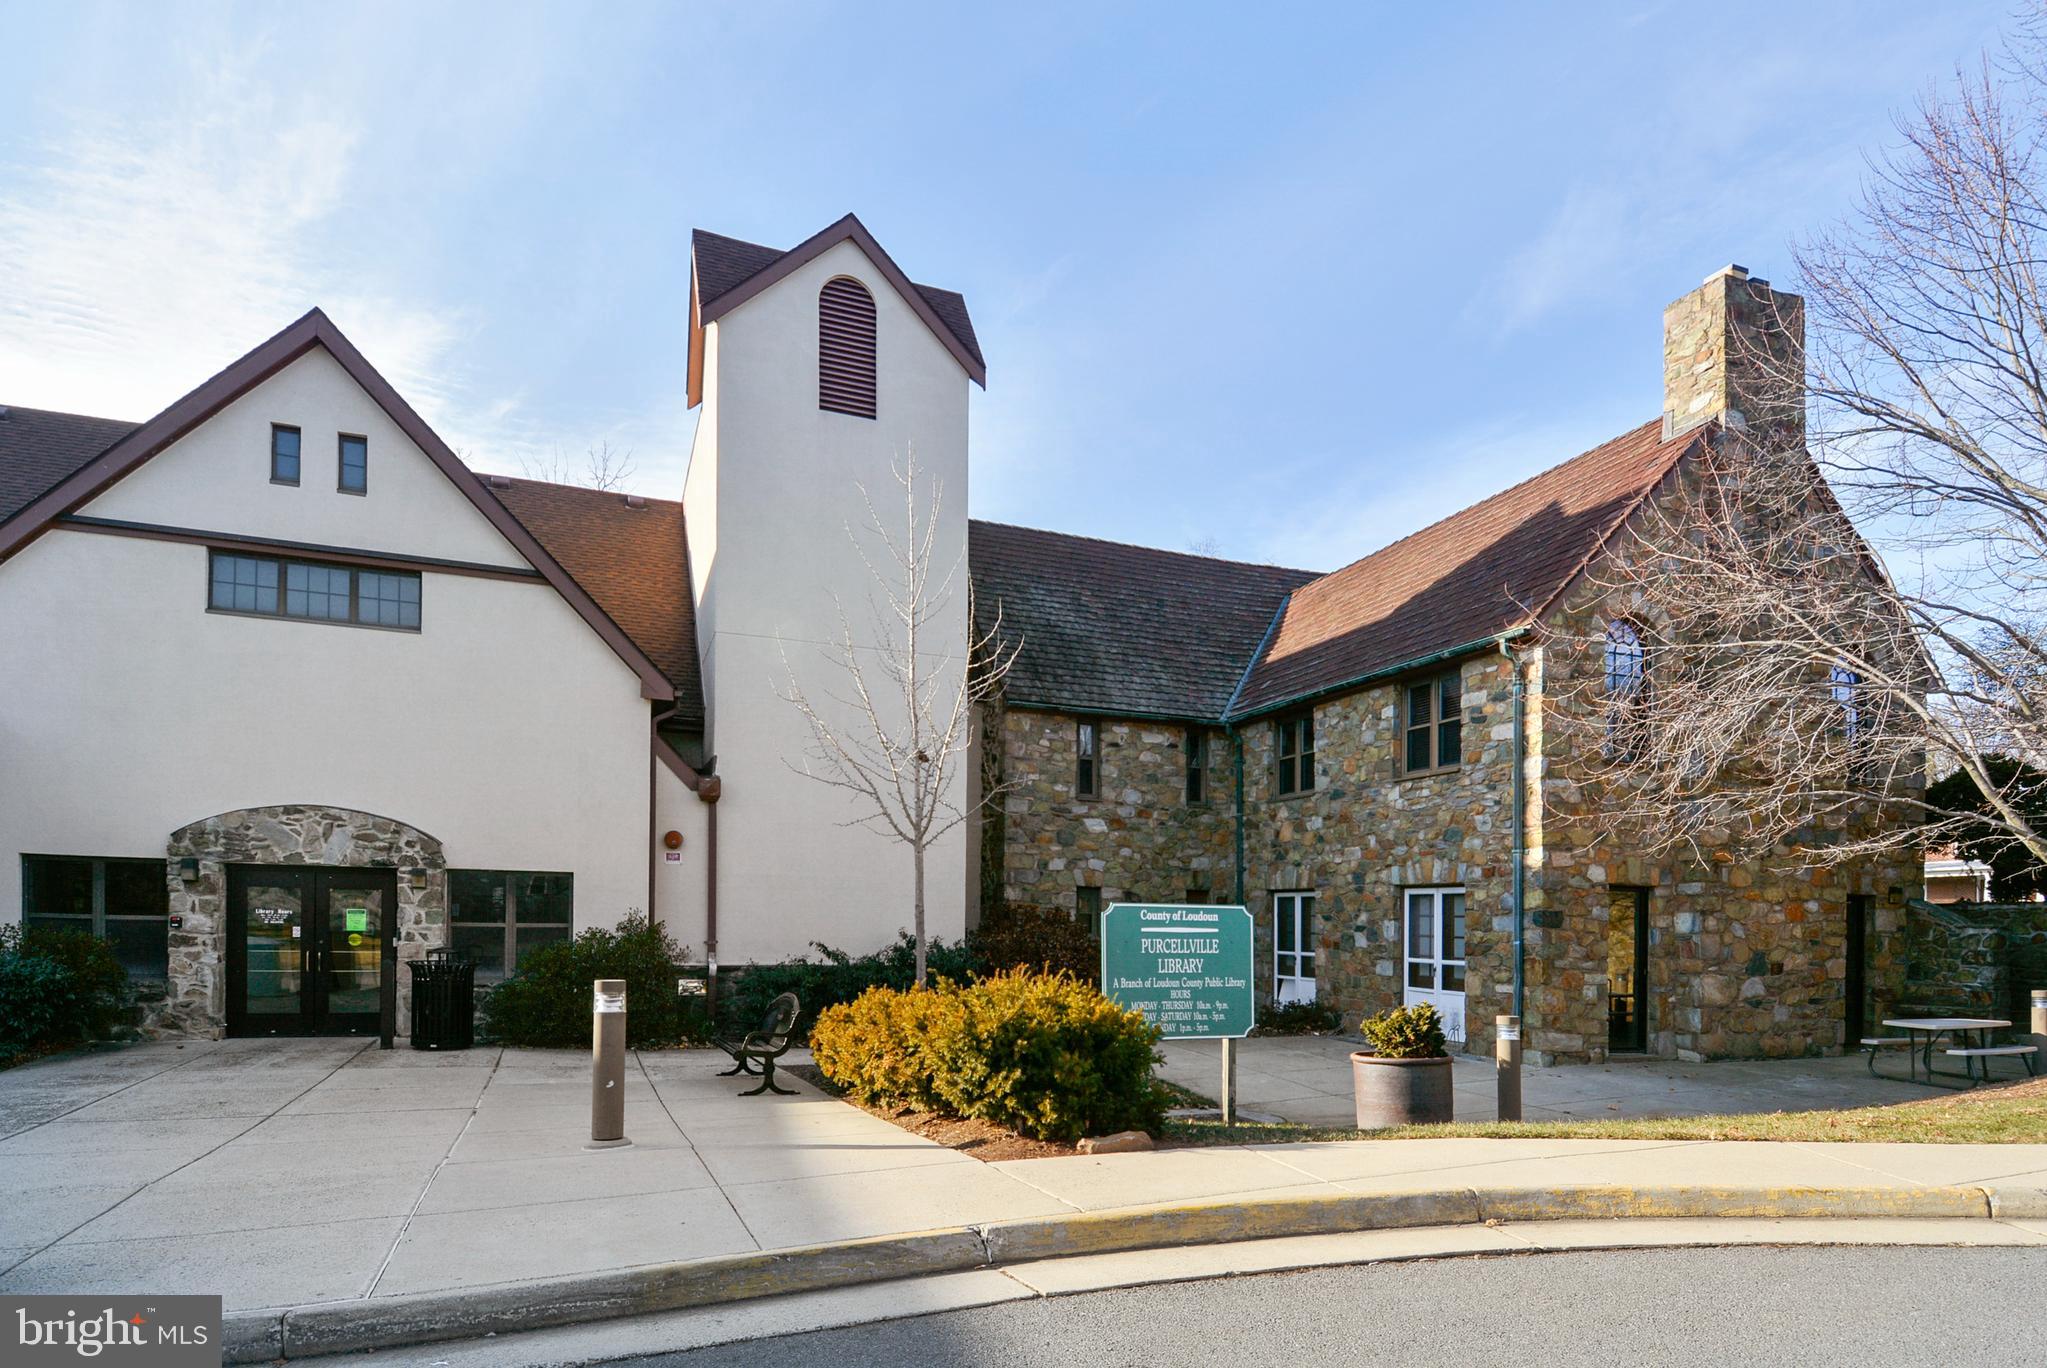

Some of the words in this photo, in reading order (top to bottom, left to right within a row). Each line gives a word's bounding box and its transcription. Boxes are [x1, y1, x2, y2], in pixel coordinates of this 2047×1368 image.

[1140, 909, 1171, 923] County
[1172, 910, 1183, 921] of
[1183, 910, 1219, 922] Loudoun
[1141, 939, 1219, 954] PURCELLVILLE
[1158, 958, 1204, 973] LIBRARY
[1113, 977, 1119, 988] A
[1120, 977, 1143, 988] Branch
[1144, 977, 1152, 988] of
[1153, 977, 1180, 988] Loudoun
[1181, 977, 1203, 990] County
[1205, 977, 1224, 988] Public
[1225, 977, 1246, 990] Library
[1170, 990, 1191, 999] HOURS
[1131, 1001, 1158, 1010] MONDAY
[1161, 1001, 1193, 1010] THURSDAY
[1161, 1012, 1192, 1021] SATURDAY
